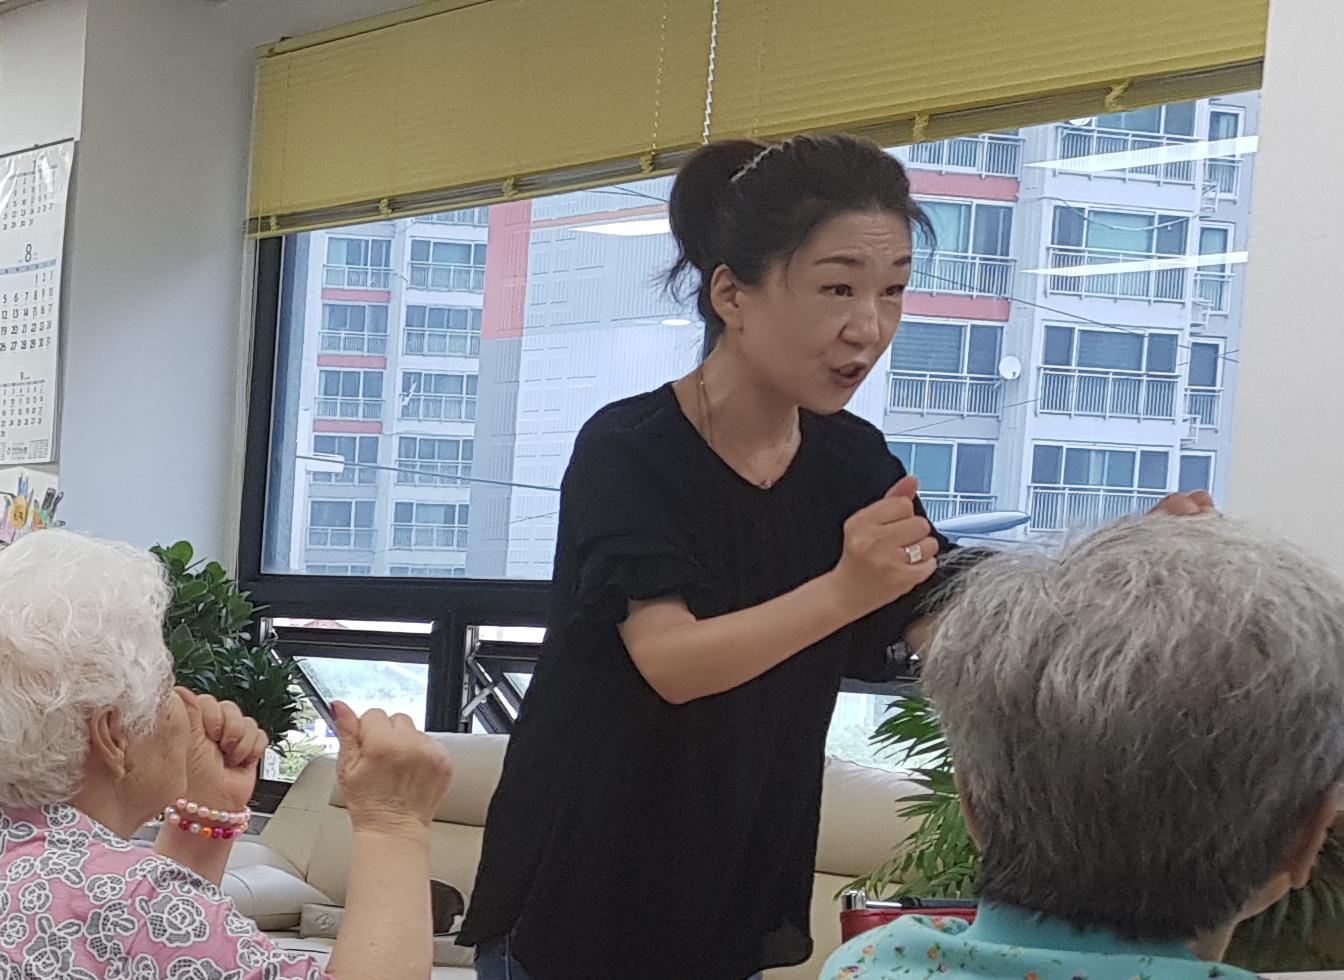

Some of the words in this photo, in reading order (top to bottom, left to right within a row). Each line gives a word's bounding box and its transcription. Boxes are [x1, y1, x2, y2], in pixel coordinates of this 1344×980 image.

[25, 243, 32, 262] 8
[1, 310, 7, 319] 12
[12, 308, 18, 318] 13
[0, 326, 7, 336] 19
[10, 324, 18, 335] 20
[0, 342, 6, 351] 26
[9, 341, 17, 351] 27
